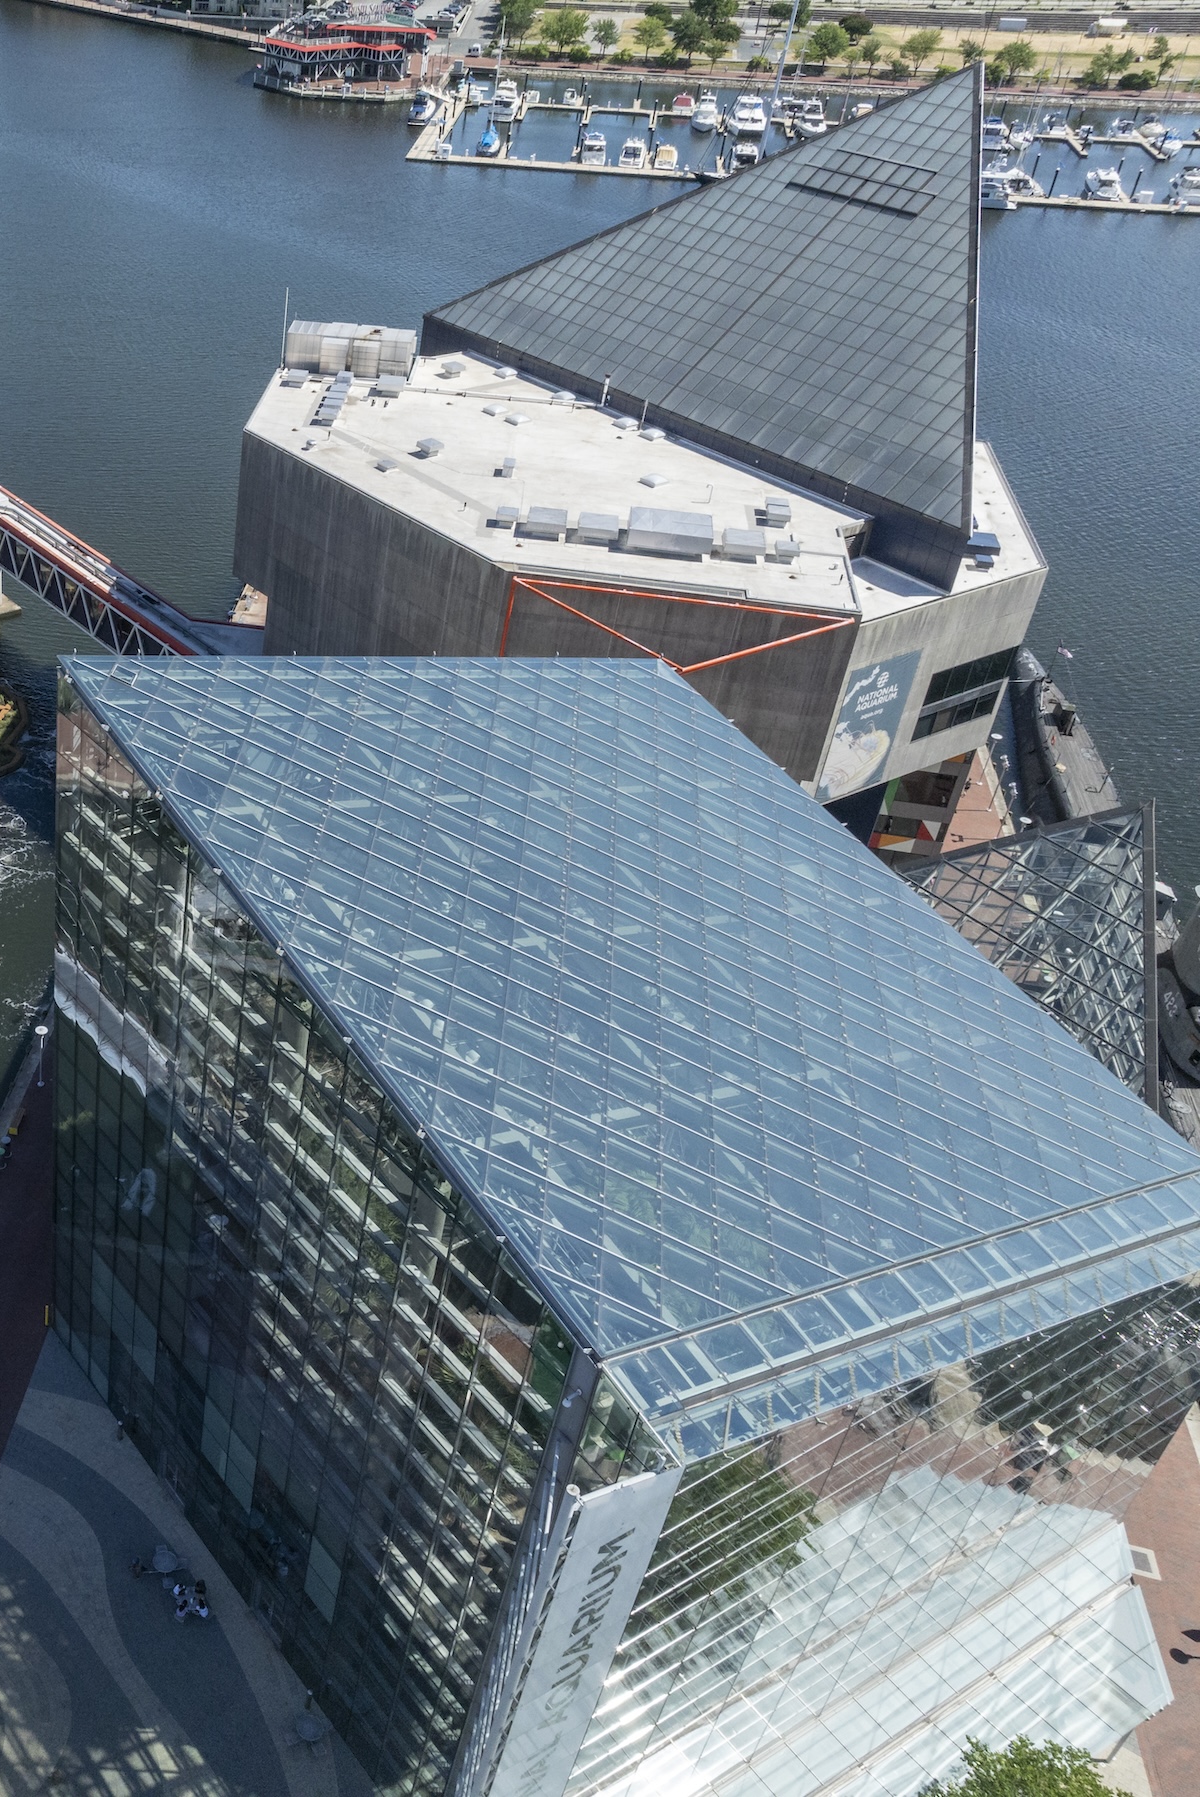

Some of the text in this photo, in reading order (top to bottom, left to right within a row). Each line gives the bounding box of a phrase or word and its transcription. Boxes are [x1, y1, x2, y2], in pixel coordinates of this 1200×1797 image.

[854, 692, 898, 713] AQUARIUM
[857, 684, 899, 704] NATIONAL
[537, 1527, 636, 1730] AQUARIUM
